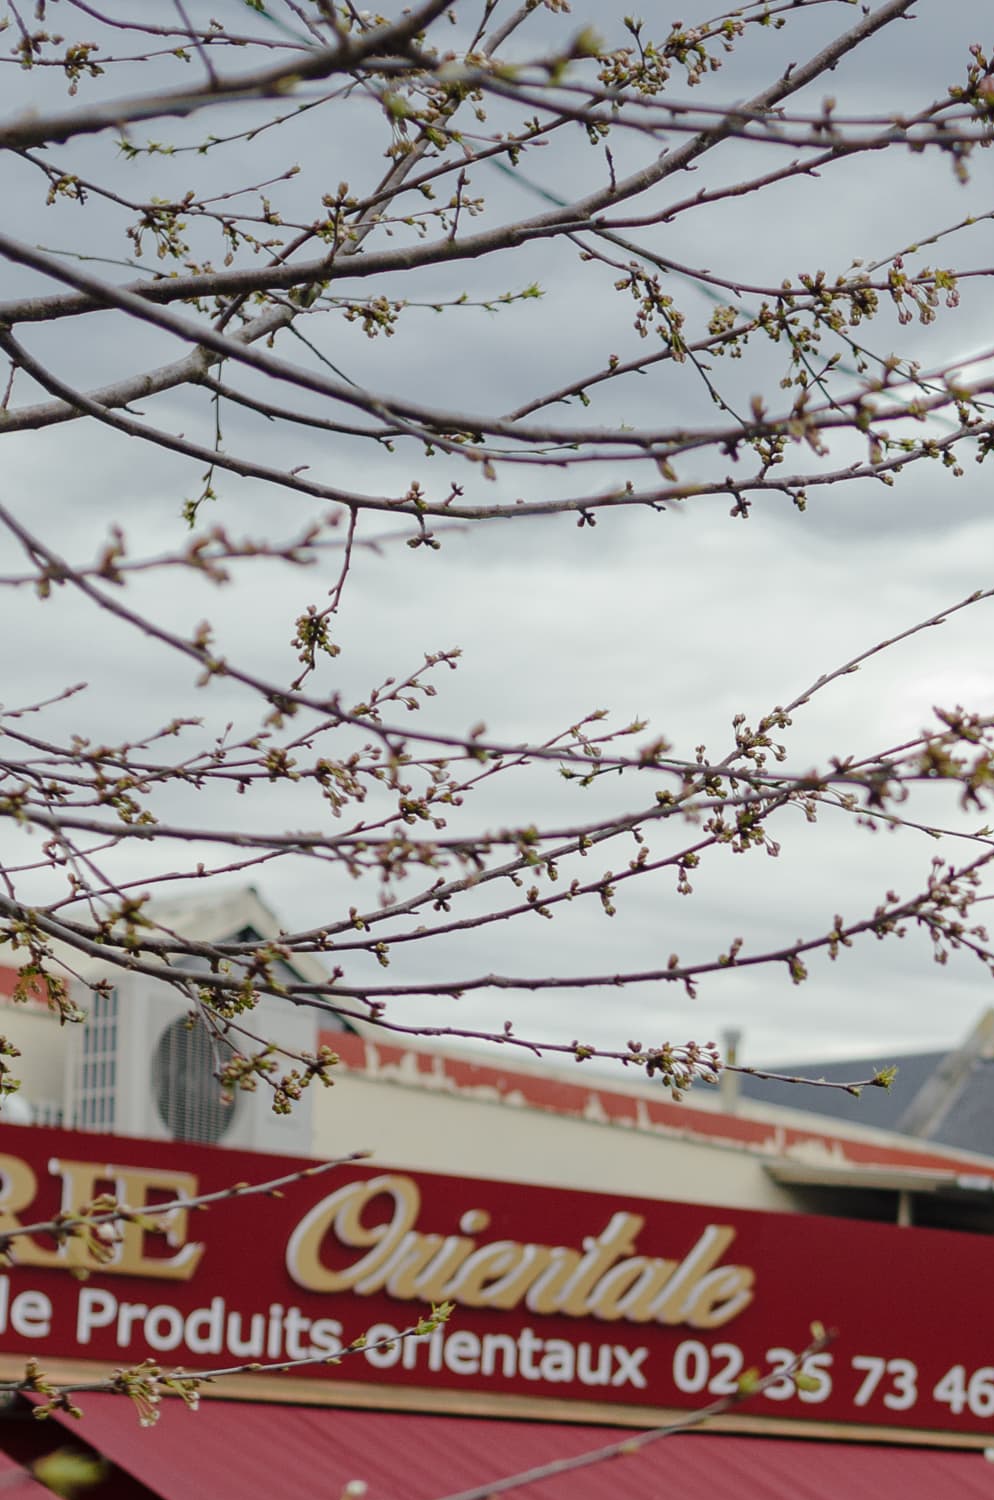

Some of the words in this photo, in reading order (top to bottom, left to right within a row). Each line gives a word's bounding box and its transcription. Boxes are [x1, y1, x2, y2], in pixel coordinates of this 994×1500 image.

[286, 1175, 755, 1330] Orientale
[76, 1286, 344, 1363] Produits
[363, 1316, 649, 1389] orientaux
[672, 1339, 745, 1395] 02
[762, 1347, 834, 1404] 35
[851, 1355, 918, 1411] 73
